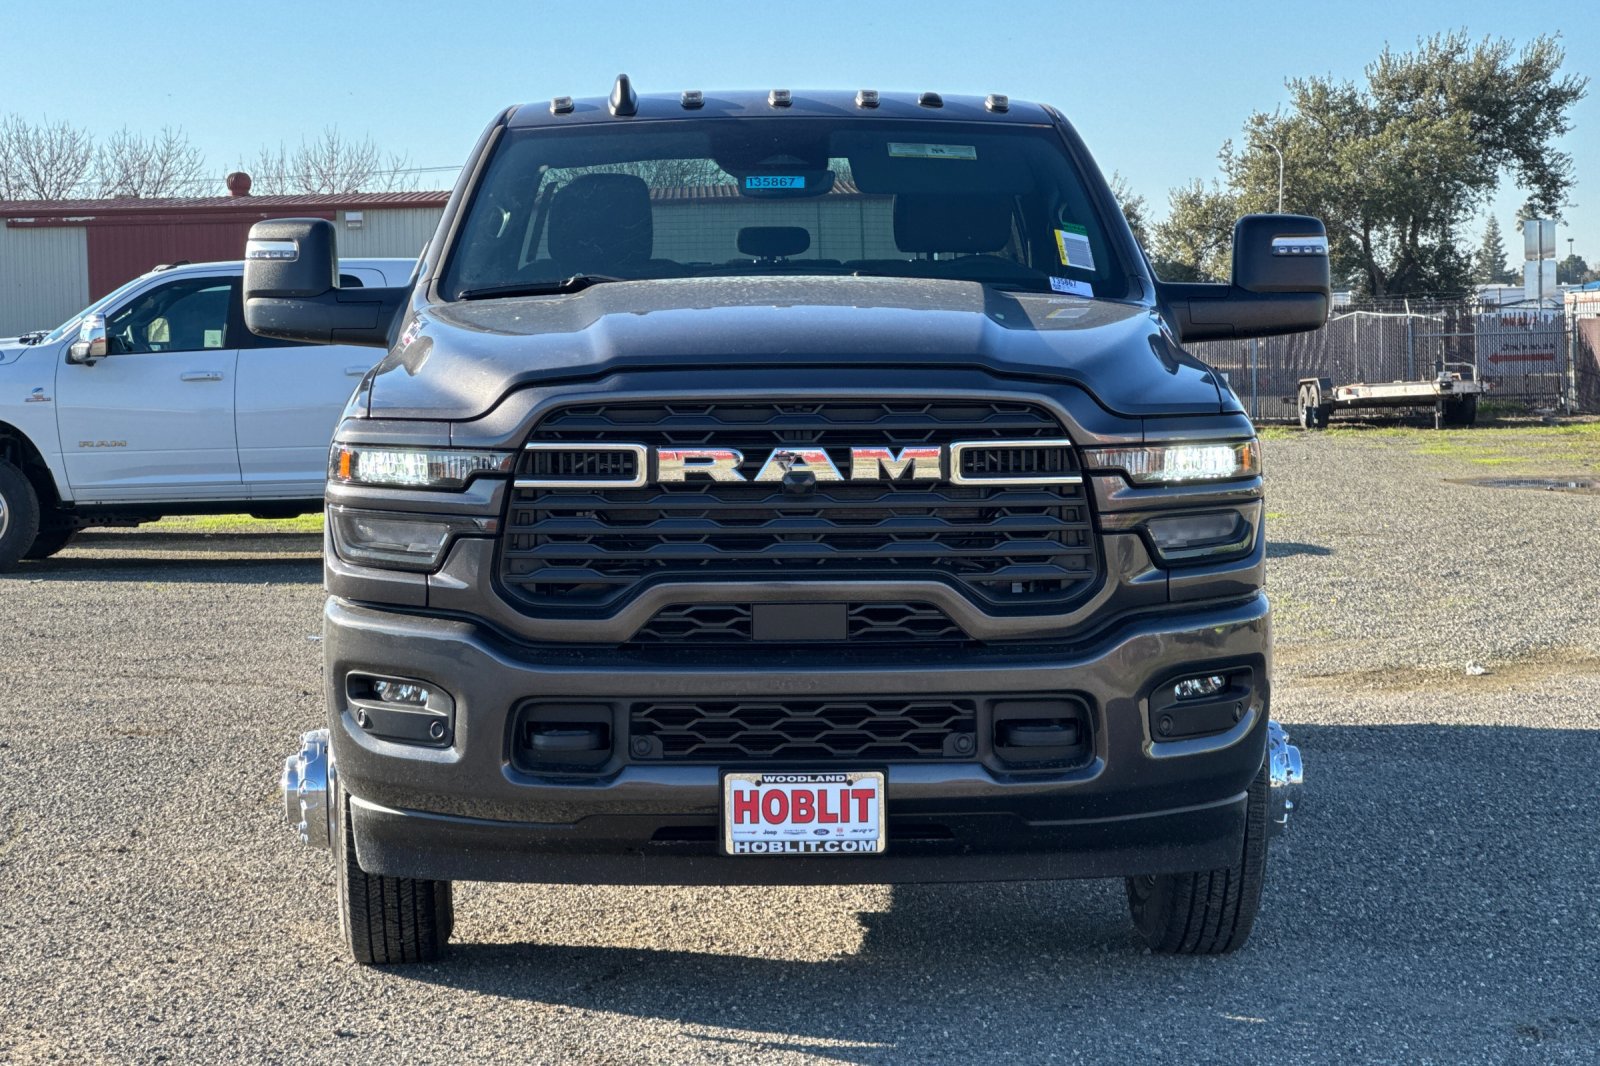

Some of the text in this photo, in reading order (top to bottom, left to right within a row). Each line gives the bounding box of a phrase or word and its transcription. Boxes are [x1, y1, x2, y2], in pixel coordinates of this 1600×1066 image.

[747, 177, 796, 187] 135867
[656, 446, 942, 482] RAM
[763, 775, 847, 783] WOODLAND
[733, 788, 876, 825] HOBLIT
[734, 841, 877, 853] HOBLIT.COM
